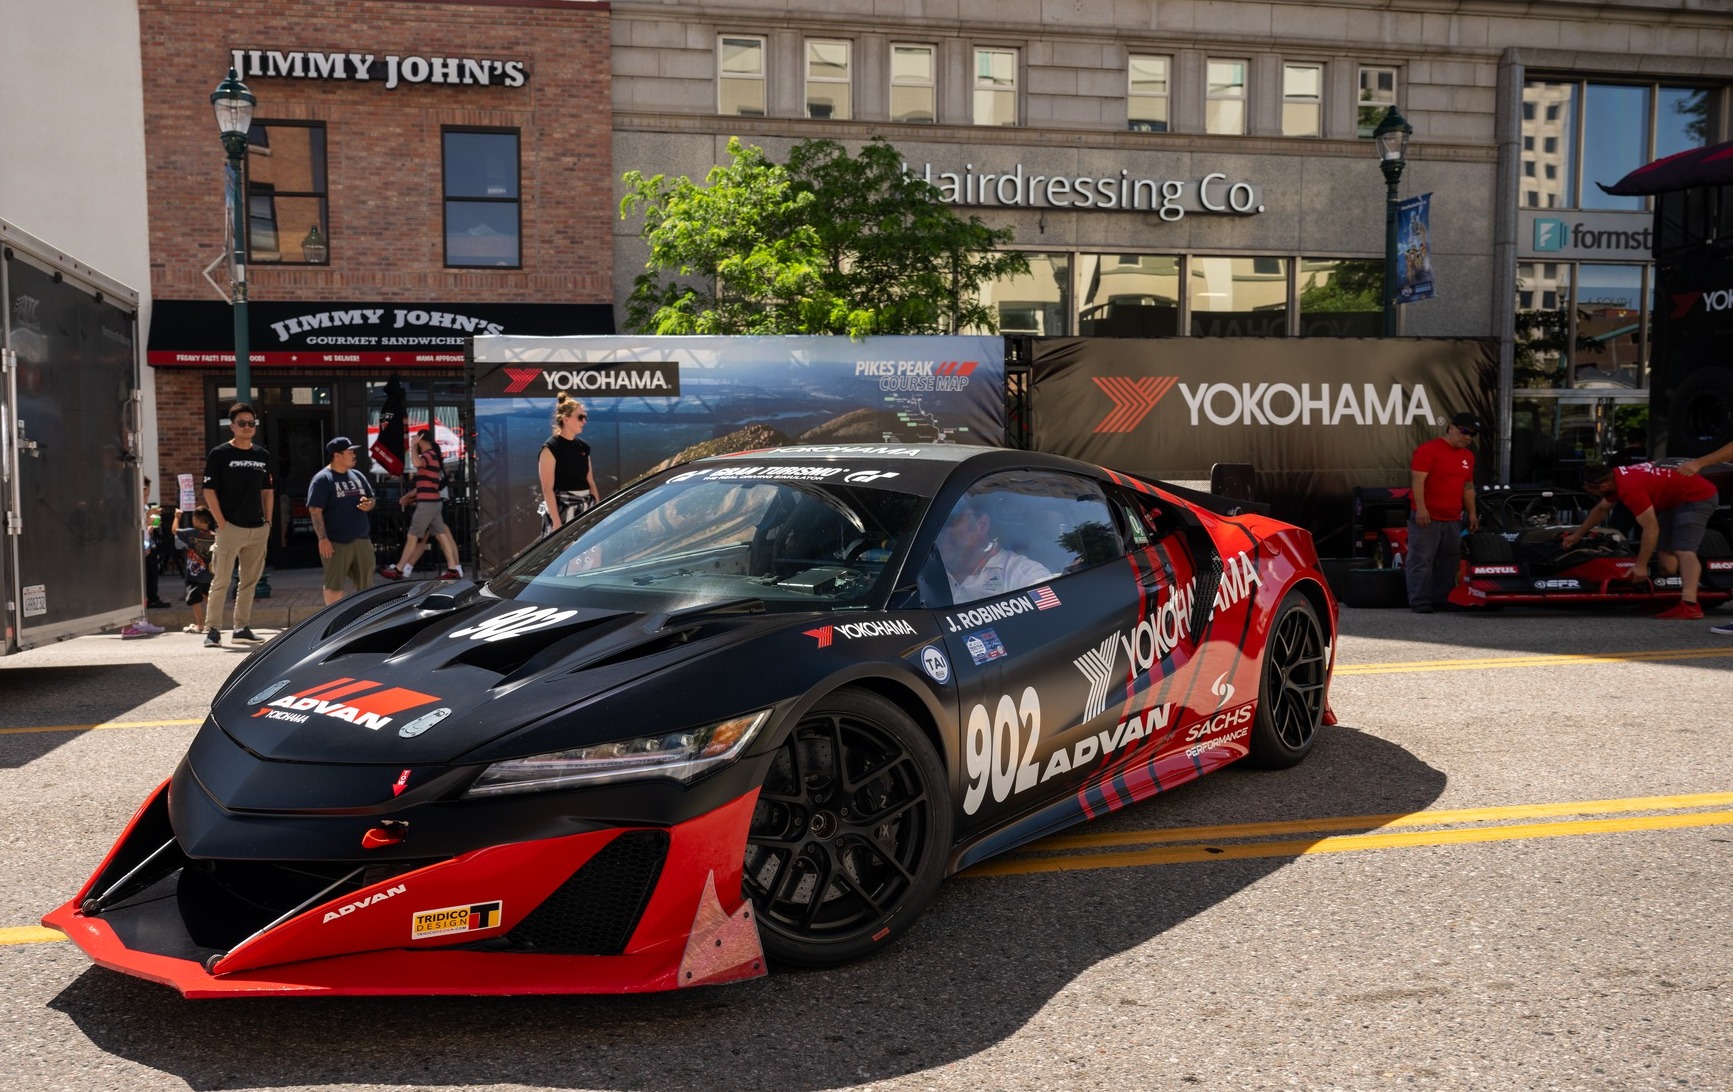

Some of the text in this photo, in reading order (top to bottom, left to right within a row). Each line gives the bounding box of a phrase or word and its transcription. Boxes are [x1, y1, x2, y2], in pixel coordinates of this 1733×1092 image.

[231, 50, 525, 89] JIMMY JOHN'S
[1200, 172, 1265, 213] Co.
[270, 309, 504, 342] JIMMY JOHN'S
[306, 336, 465, 345] GOURMET SANDWICHE
[542, 370, 667, 389] YOKOHAMA
[855, 360, 934, 376] PIKES PEAK
[879, 375, 969, 391] COURSE MAP
[1178, 382, 1436, 426] YOKOHAMA
[1474, 566, 1517, 574] MOTUL
[449, 606, 578, 642] 902
[834, 619, 917, 639] YOKOHAMA
[945, 595, 1035, 633] J. ROBINSON
[265, 709, 309, 723] YOKOHAMA
[267, 695, 393, 730] ADVAN
[1185, 705, 1252, 741] SACHS
[963, 686, 1041, 815] 902
[1040, 702, 1171, 783] ADVAN
[1185, 727, 1249, 759] PERFORMANCE
[397, 770, 410, 785] TOW
[322, 884, 407, 923] ADVAN
[416, 909, 468, 924] TRIDICO
[416, 919, 467, 932] DESIGN
